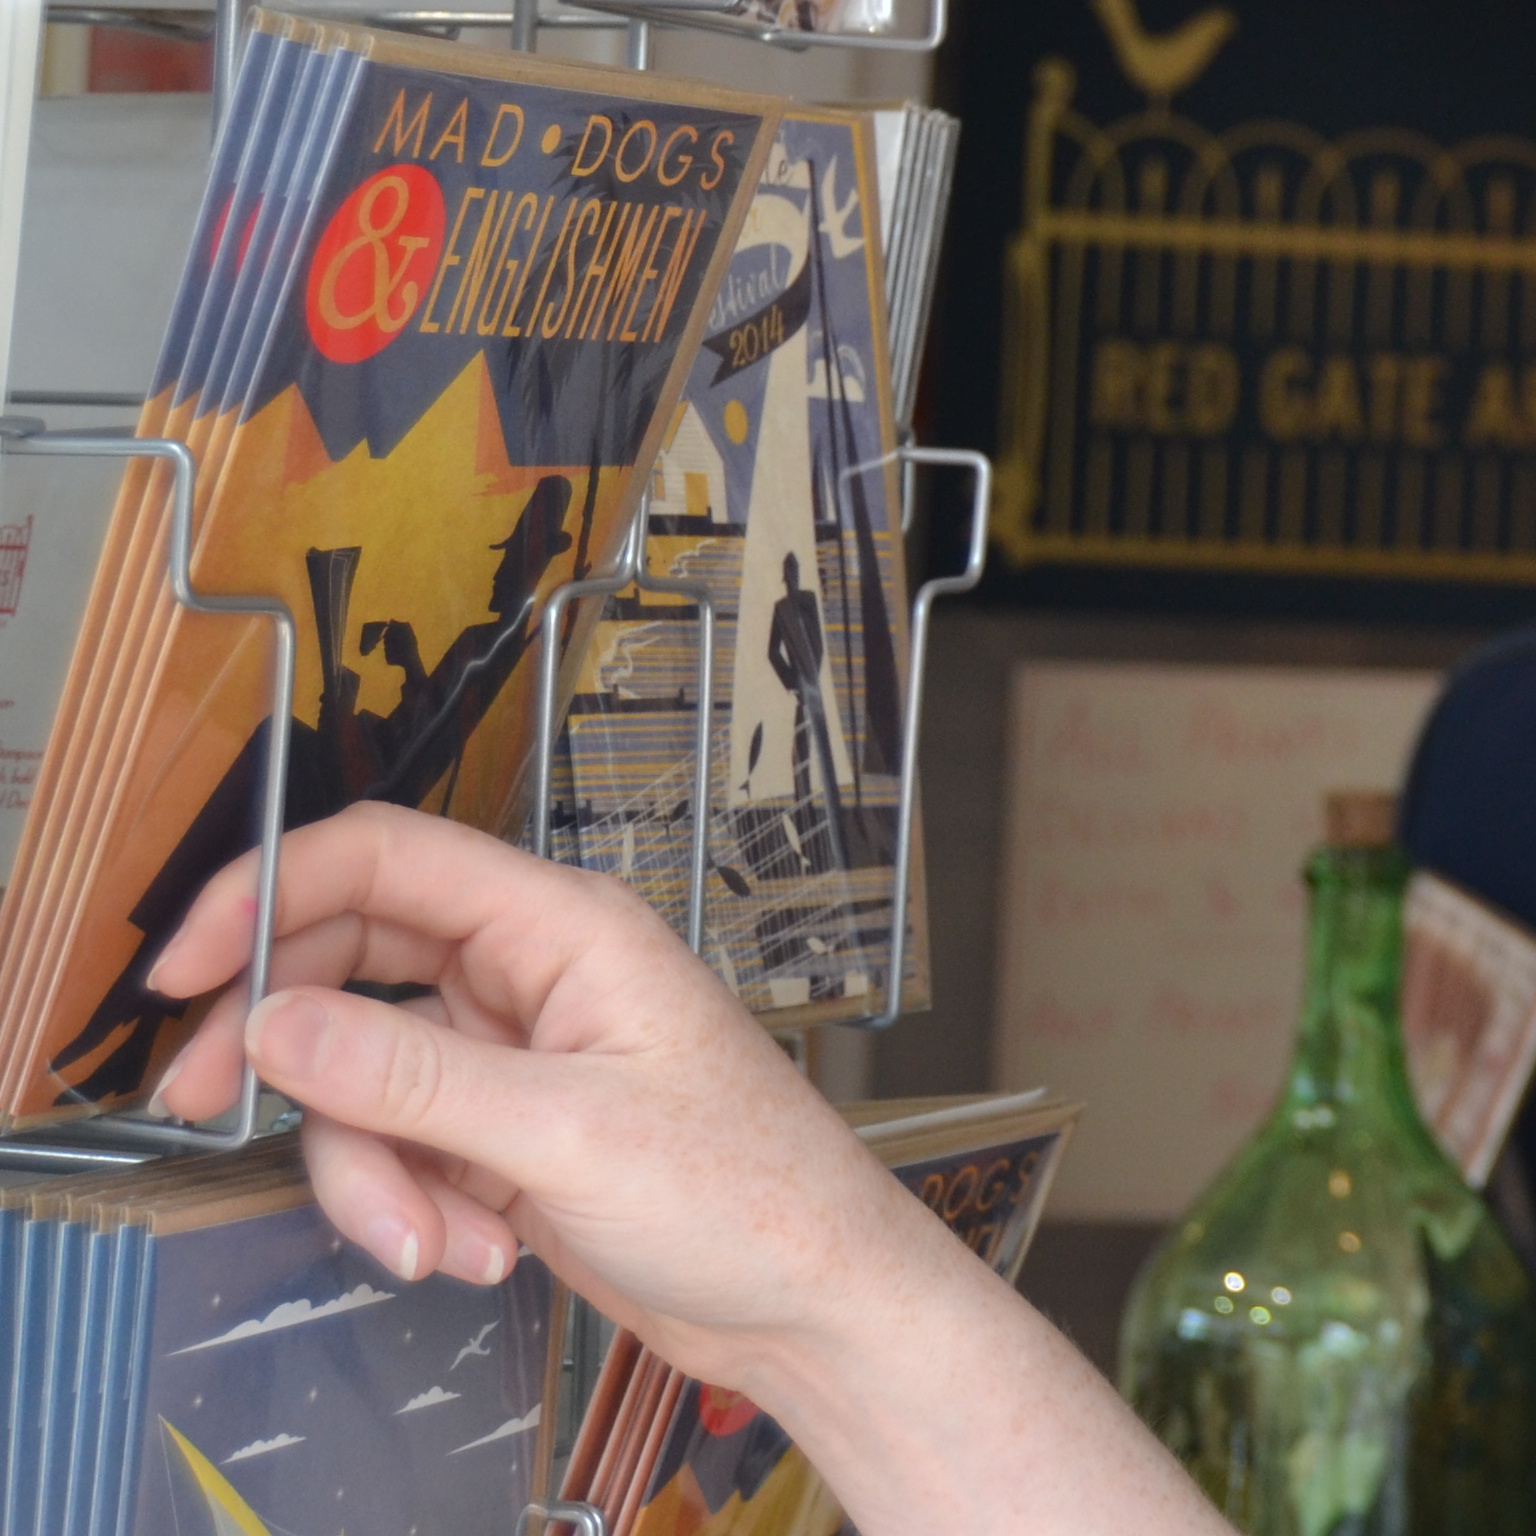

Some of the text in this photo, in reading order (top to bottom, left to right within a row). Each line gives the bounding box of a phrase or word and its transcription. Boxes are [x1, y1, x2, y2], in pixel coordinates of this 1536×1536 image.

[373, 87, 736, 191] MAD DOGS
[318, 175, 709, 345] & ENGLISHMEN
[728, 303, 786, 368] 2014
[1089, 340, 1242, 436] RED
[1258, 344, 1450, 448] GATE
